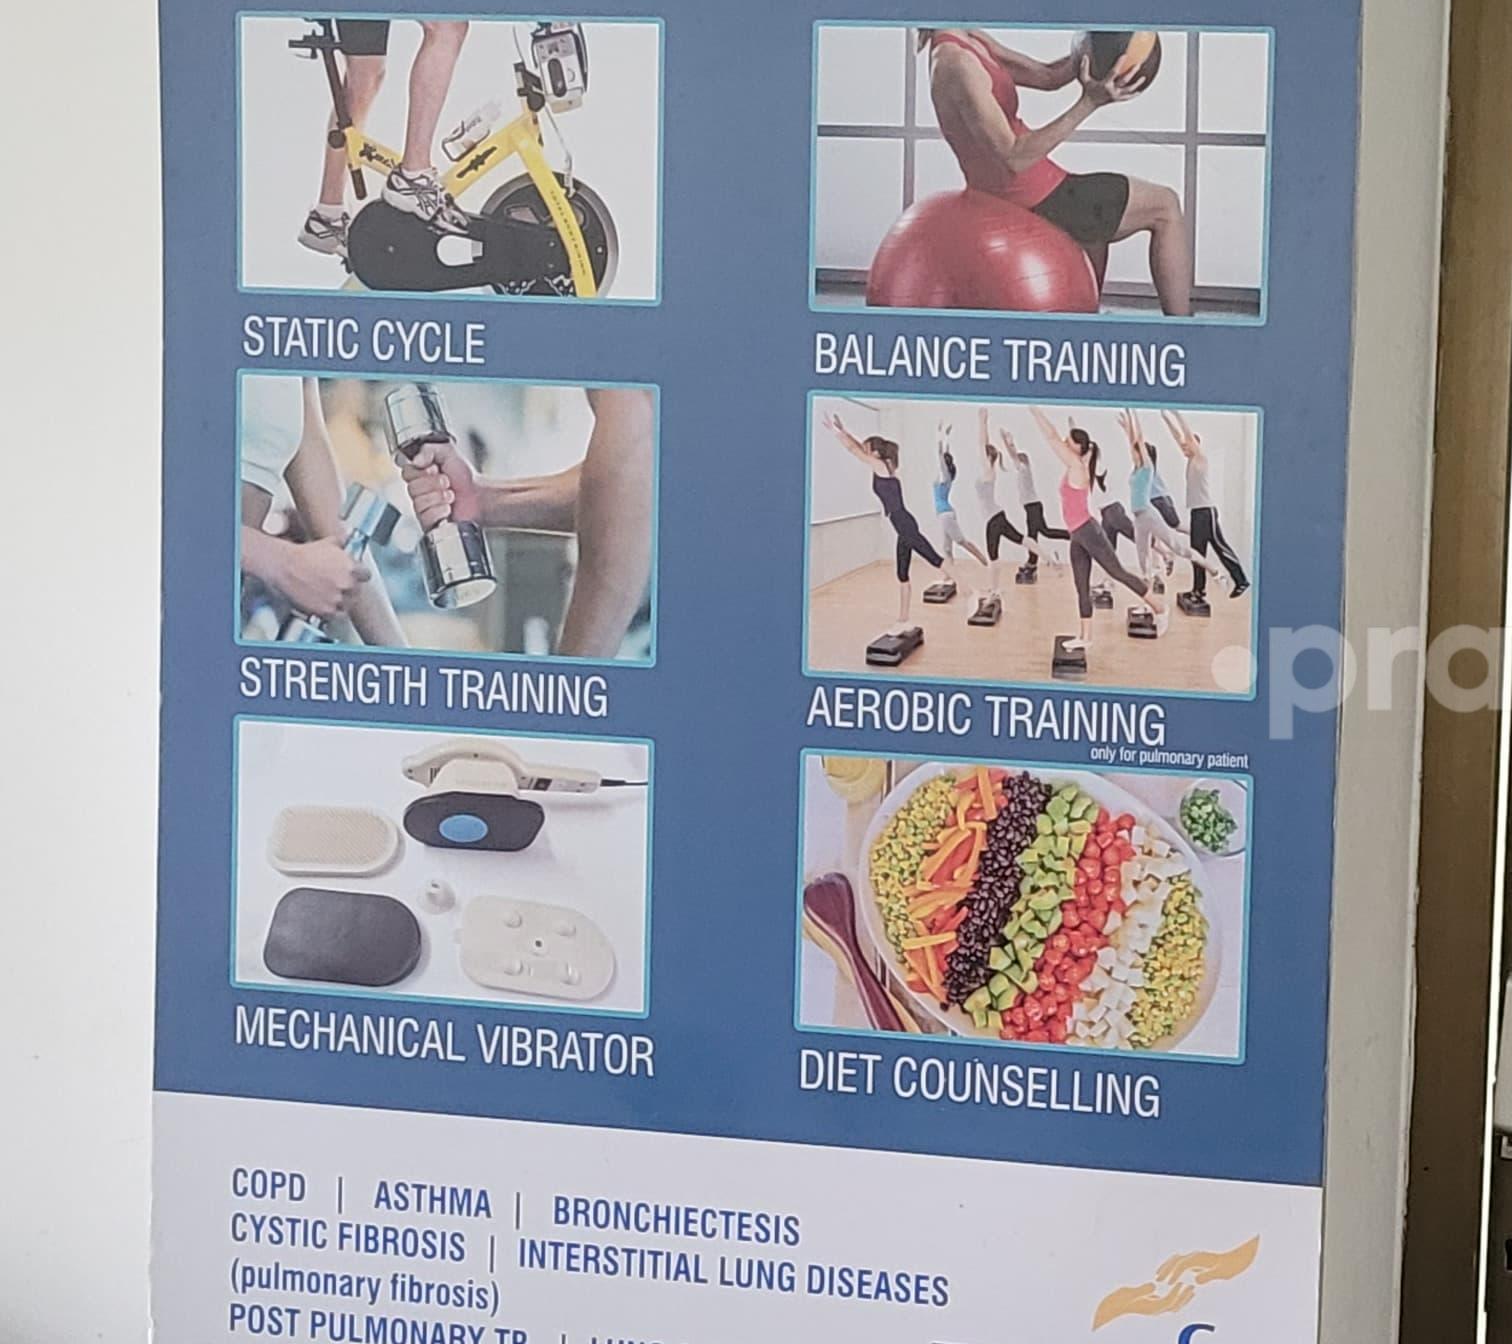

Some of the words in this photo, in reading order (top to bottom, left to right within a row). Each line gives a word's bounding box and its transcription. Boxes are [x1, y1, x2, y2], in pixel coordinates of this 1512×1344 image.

[243, 315, 359, 359] STATIC
[372, 319, 485, 364] CYCLE
[815, 333, 990, 381] BALANCE
[1003, 339, 1186, 387] TRAINING
[239, 656, 426, 707] STRENGTH
[439, 667, 608, 717] TRAINING
[806, 686, 971, 738] AEROBIC
[985, 695, 1166, 746] TRAINING
[1090, 747, 1116, 763] only
[1119, 747, 1136, 762] for
[1139, 749, 1204, 768] pulmonary
[1207, 753, 1249, 769] patient
[235, 1005, 466, 1063] MECHANICAL
[477, 1023, 655, 1077] VIBRATOR
[800, 1049, 882, 1094] DIET
[893, 1056, 1160, 1118] COUNSELLING
[232, 1168, 306, 1202] COPD
[374, 1180, 492, 1218] ASTHMA
[553, 1195, 801, 1246] BRONCHIECTESIS
[230, 1258, 382, 1306] (pulmonary
[390, 1276, 501, 1317] fibrosis)
[231, 1212, 328, 1249] CYSTIC
[338, 1222, 466, 1262] FIBROSIS
[518, 1238, 708, 1285] INTERSTITIAL
[719, 1256, 796, 1293] LUNG
[806, 1263, 950, 1308] DISEASES
[229, 1304, 301, 1336] POST
